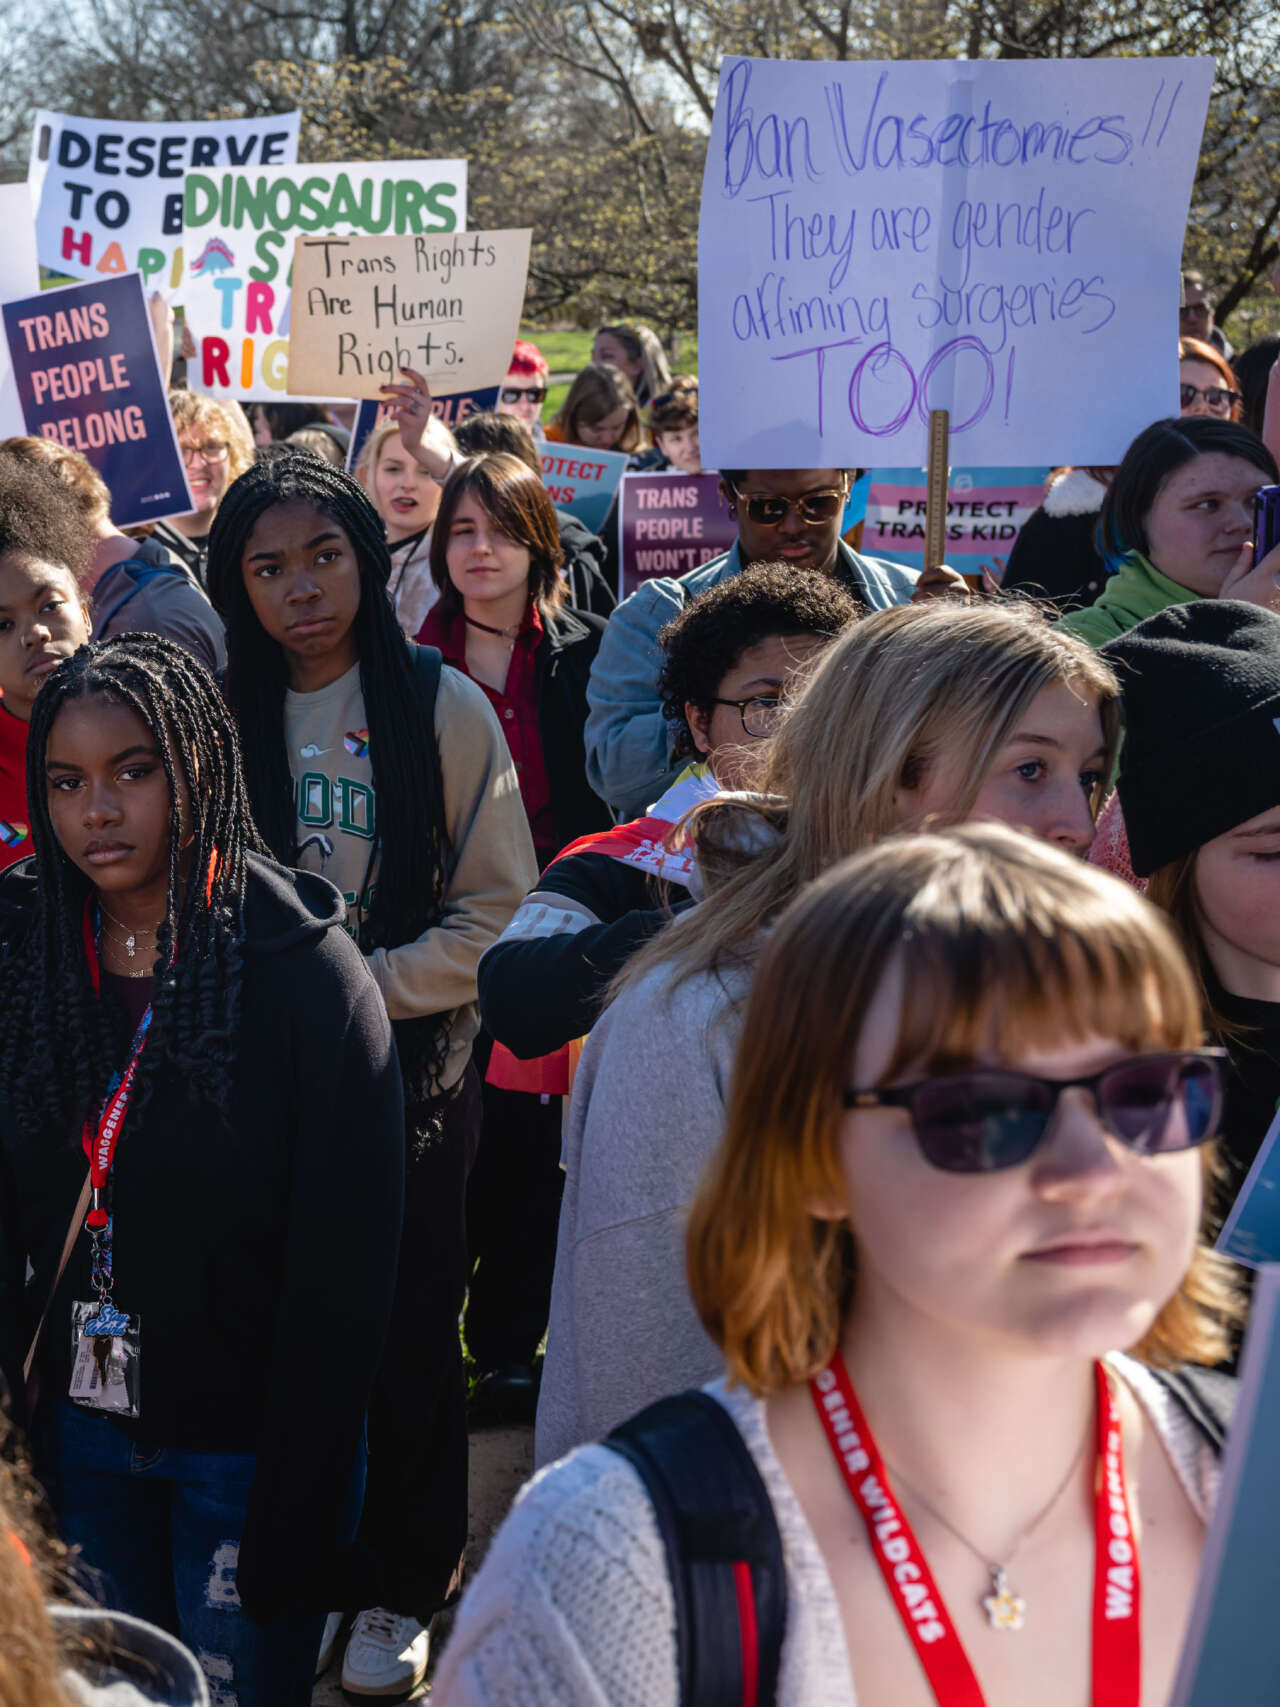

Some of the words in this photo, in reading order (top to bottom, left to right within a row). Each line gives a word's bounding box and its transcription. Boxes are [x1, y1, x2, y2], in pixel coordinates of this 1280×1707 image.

[38, 124, 52, 162] I
[57, 130, 290, 178] DESERVE
[720, 59, 822, 198] Ban
[64, 181, 131, 230] TO
[162, 194, 184, 235] B
[184, 172, 457, 234] DINOSAURS
[304, 240, 397, 279] Trans
[415, 235, 497, 284] Rights
[746, 190, 857, 289] They
[870, 203, 932, 254] are
[951, 187, 1097, 290] gender
[18, 302, 111, 353] TRANS
[307, 286, 352, 317] Are
[373, 284, 463, 330] Human
[911, 275, 1117, 355] surgeries
[31, 354, 131, 405] PEOPLE
[337, 332, 464, 385] Rights.
[771, 335, 1017, 438] TOO!
[40, 405, 148, 452] BELONG
[635, 486, 699, 511] TRANS
[635, 516, 704, 541] PEOPLE
[875, 521, 963, 541] TRAS
[635, 549, 697, 572] WON'T
[98, 1091, 129, 1170] WAGGENER
[859, 1475, 946, 1644] WILDCATS
